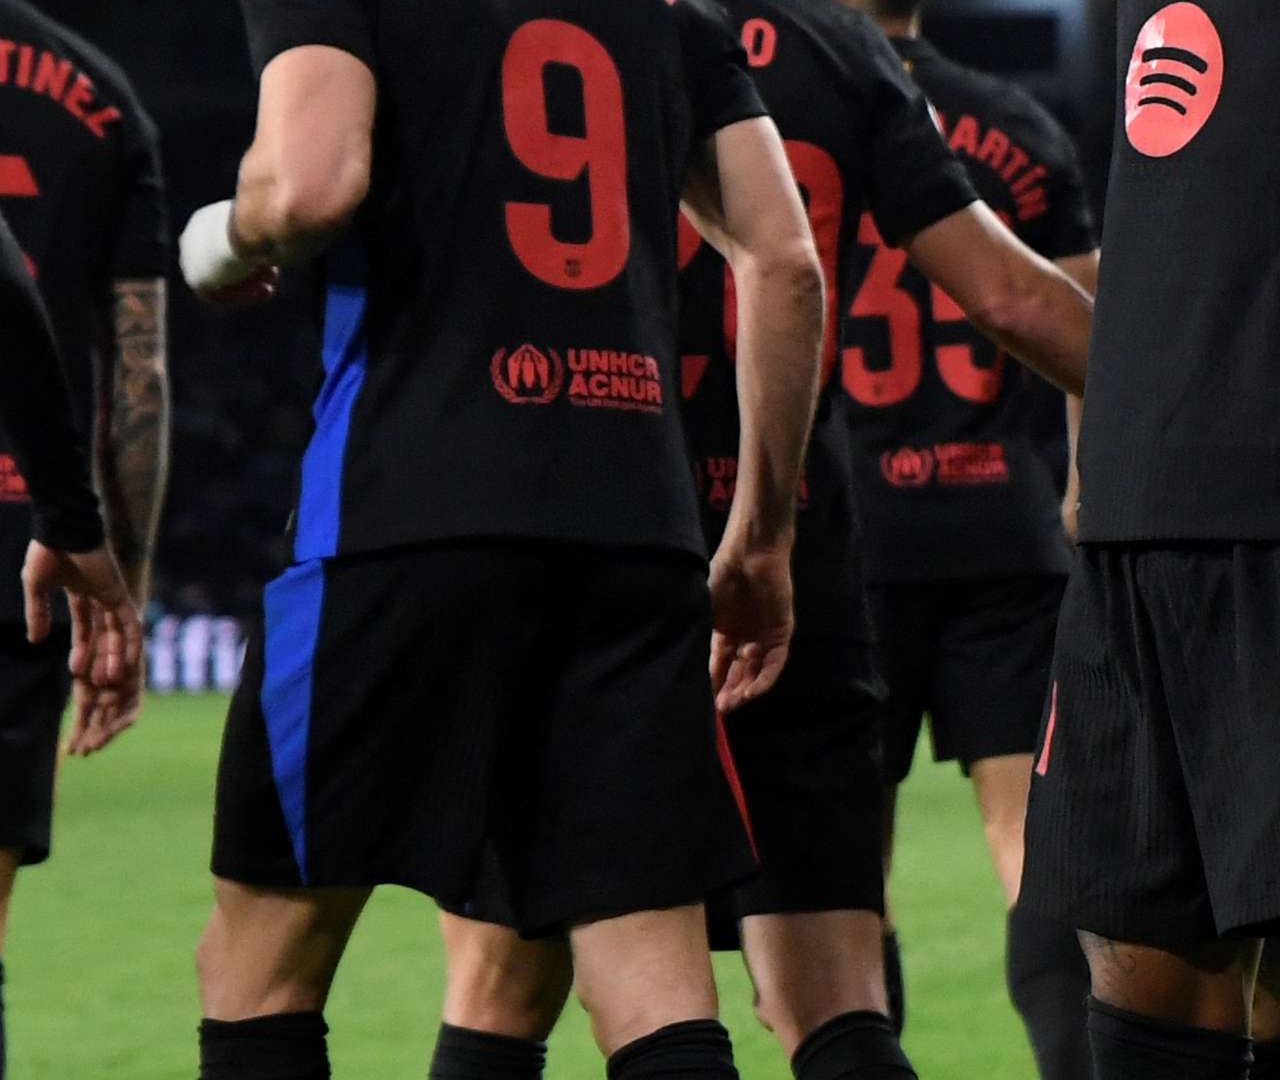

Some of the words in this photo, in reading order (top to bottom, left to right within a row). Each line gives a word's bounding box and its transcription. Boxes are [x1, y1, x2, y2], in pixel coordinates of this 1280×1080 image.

[501, 19, 630, 290] 9
[934, 109, 1048, 221] ARTÍN
[567, 348, 660, 381] UNHCR
[570, 372, 662, 404] ACNUR
